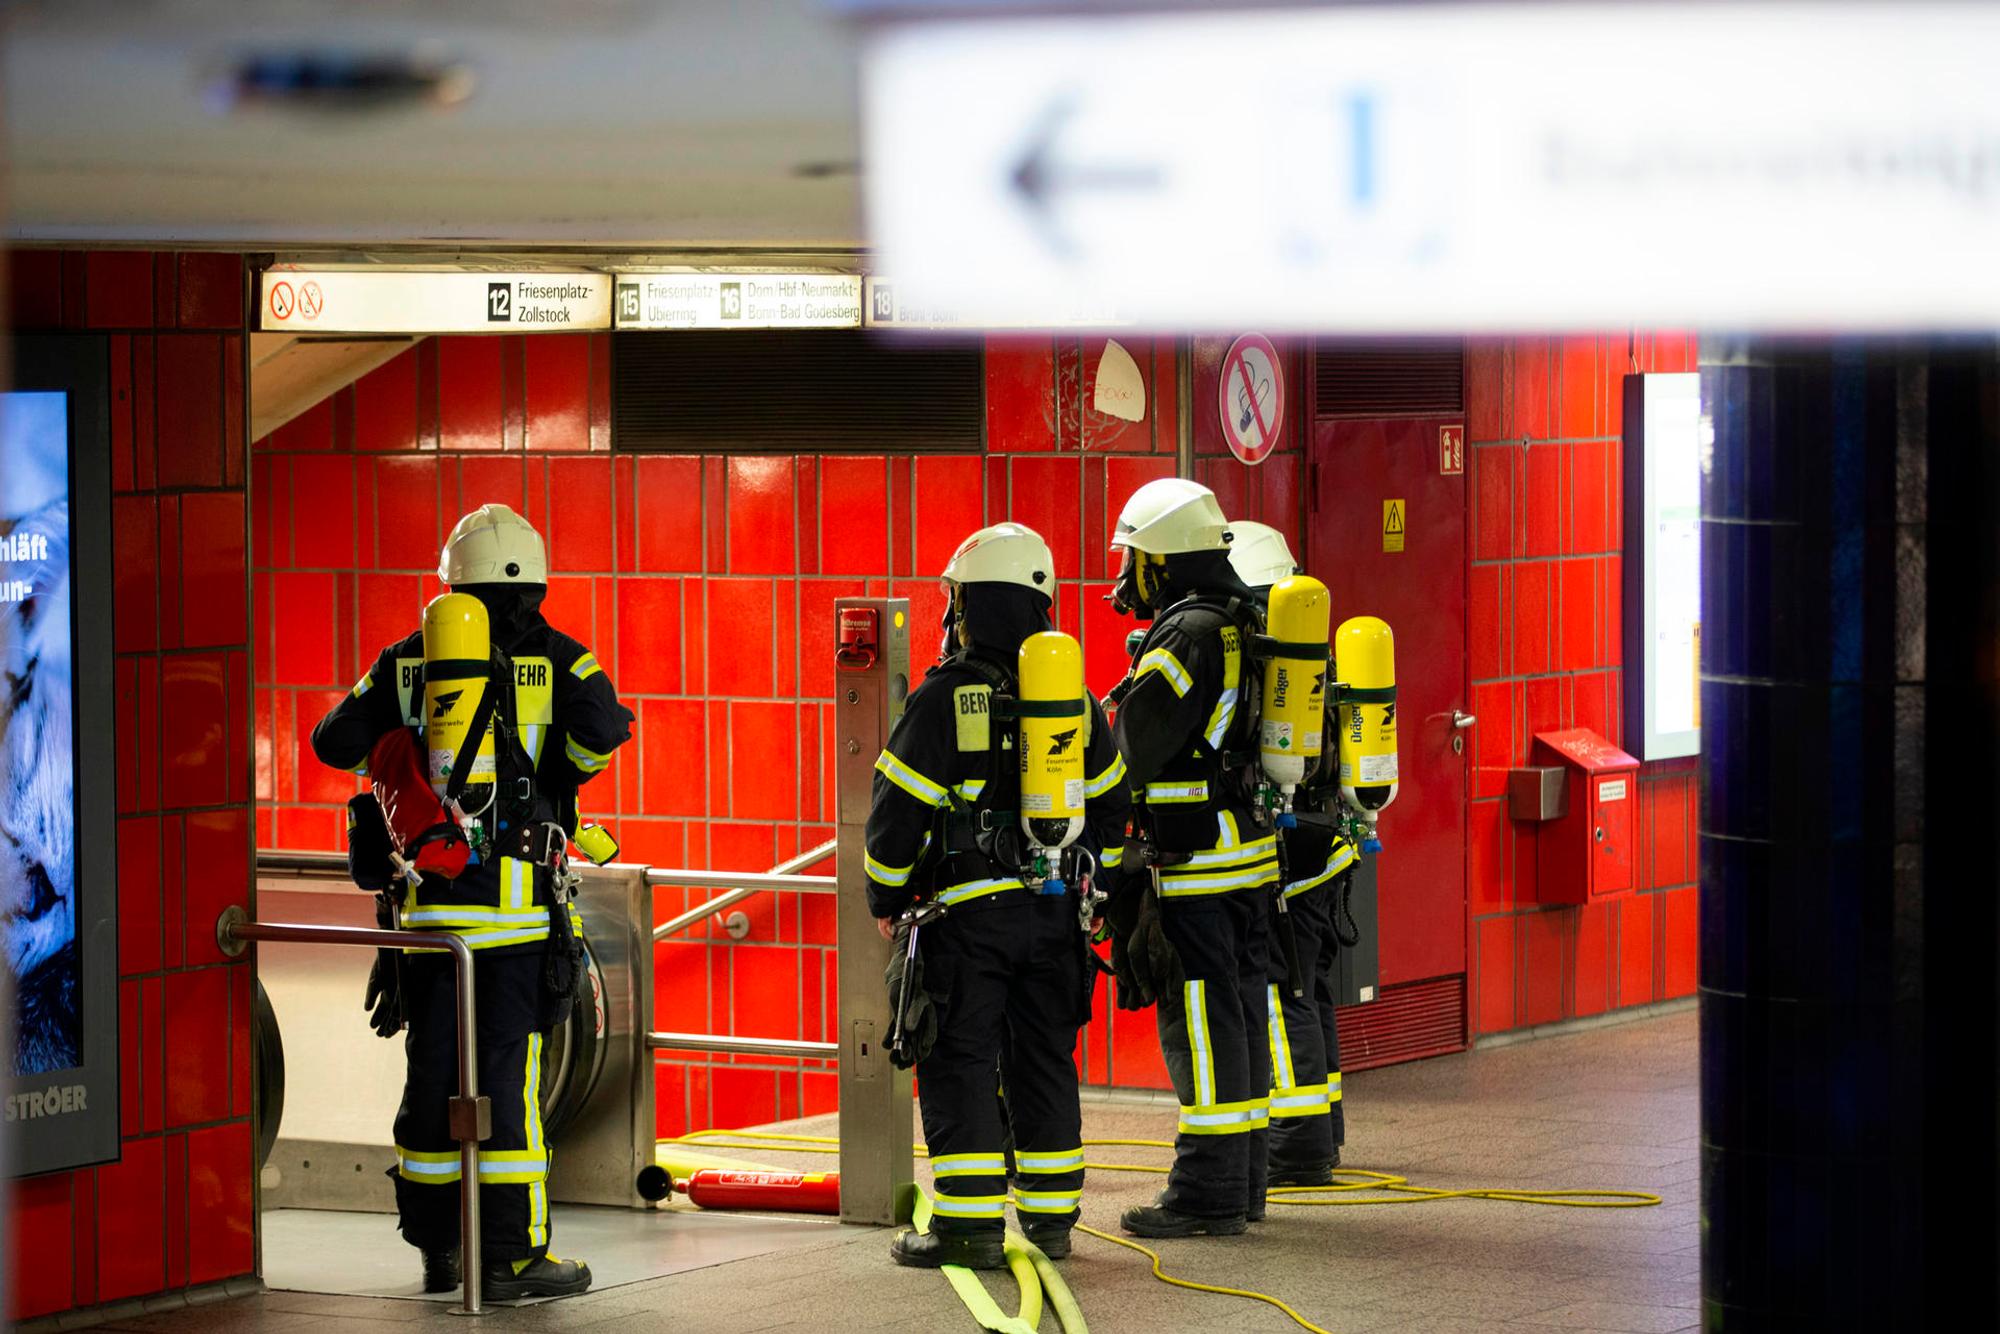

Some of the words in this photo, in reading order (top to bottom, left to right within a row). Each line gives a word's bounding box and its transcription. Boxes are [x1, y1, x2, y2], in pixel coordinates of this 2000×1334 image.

[489, 288, 510, 316] 12
[517, 282, 593, 302] Friesenplatz-
[619, 288, 639, 316] 15
[721, 287, 740, 315] 16
[874, 290, 892, 316] 18
[518, 306, 571, 323] Zollstock
[747, 303, 801, 320] Bonn-Bad
[804, 303, 861, 323] Godesberg
[1274, 667, 1289, 708] Dräger
[1350, 703, 1364, 743] Dräger
[5, 1085, 88, 1122] STRÖER
